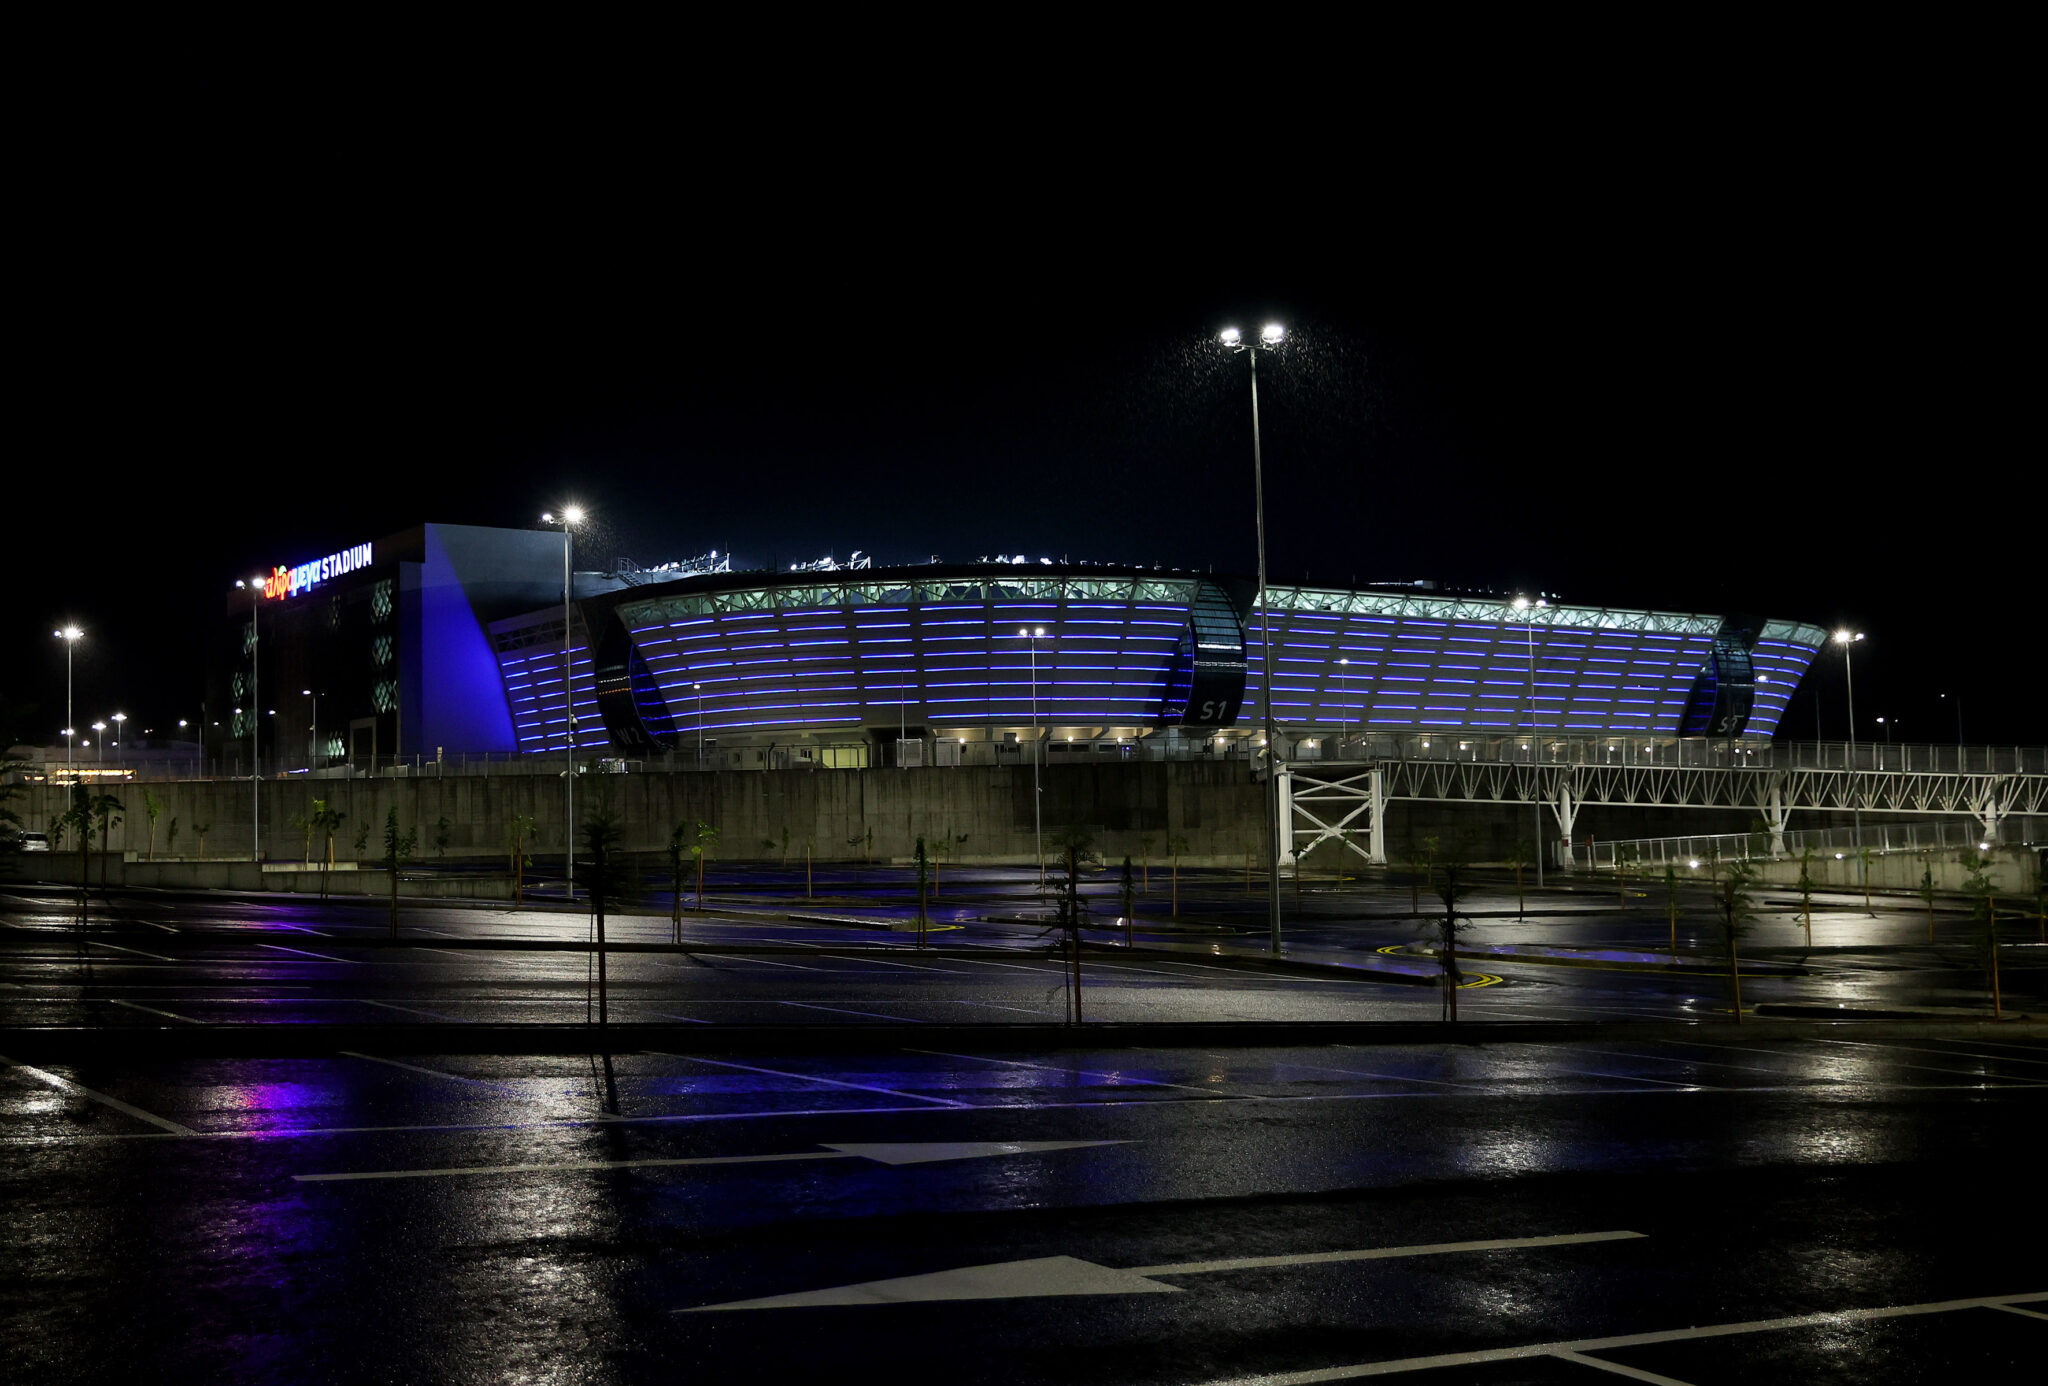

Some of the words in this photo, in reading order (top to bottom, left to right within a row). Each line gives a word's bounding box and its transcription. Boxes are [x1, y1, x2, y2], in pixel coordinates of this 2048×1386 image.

[321, 542, 372, 580] STADIUM
[1199, 700, 1227, 720] S1
[615, 727, 646, 745] W2
